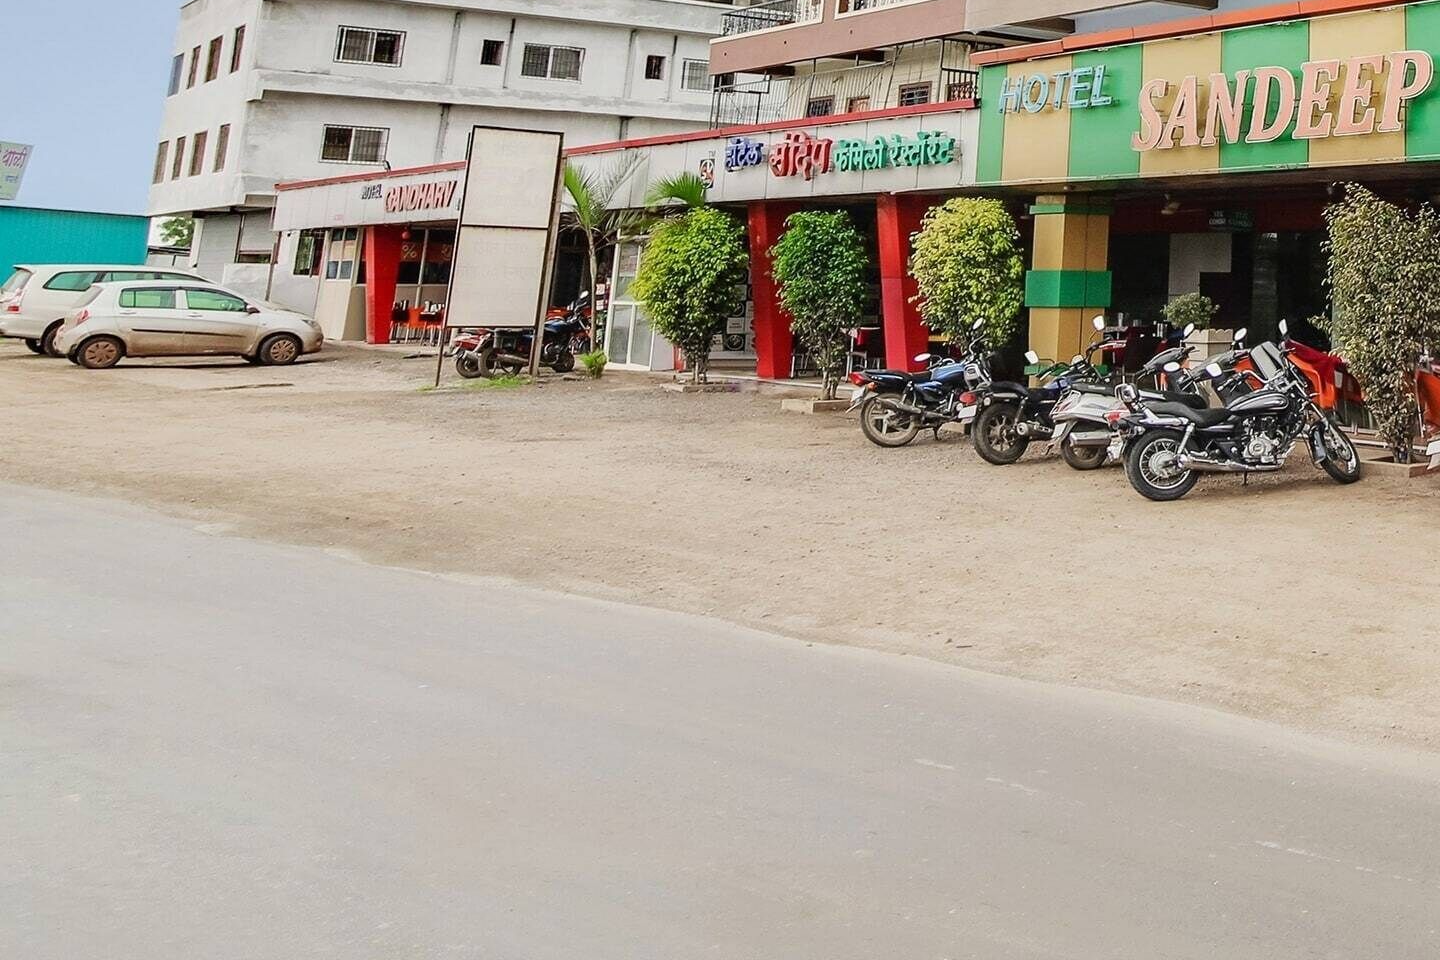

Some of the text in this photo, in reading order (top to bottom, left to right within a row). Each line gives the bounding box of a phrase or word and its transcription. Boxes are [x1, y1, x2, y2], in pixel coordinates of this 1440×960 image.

[998, 64, 1114, 115] HOTEL
[1131, 49, 1435, 152] SANDEEP
[385, 180, 458, 214] GANDHARV
